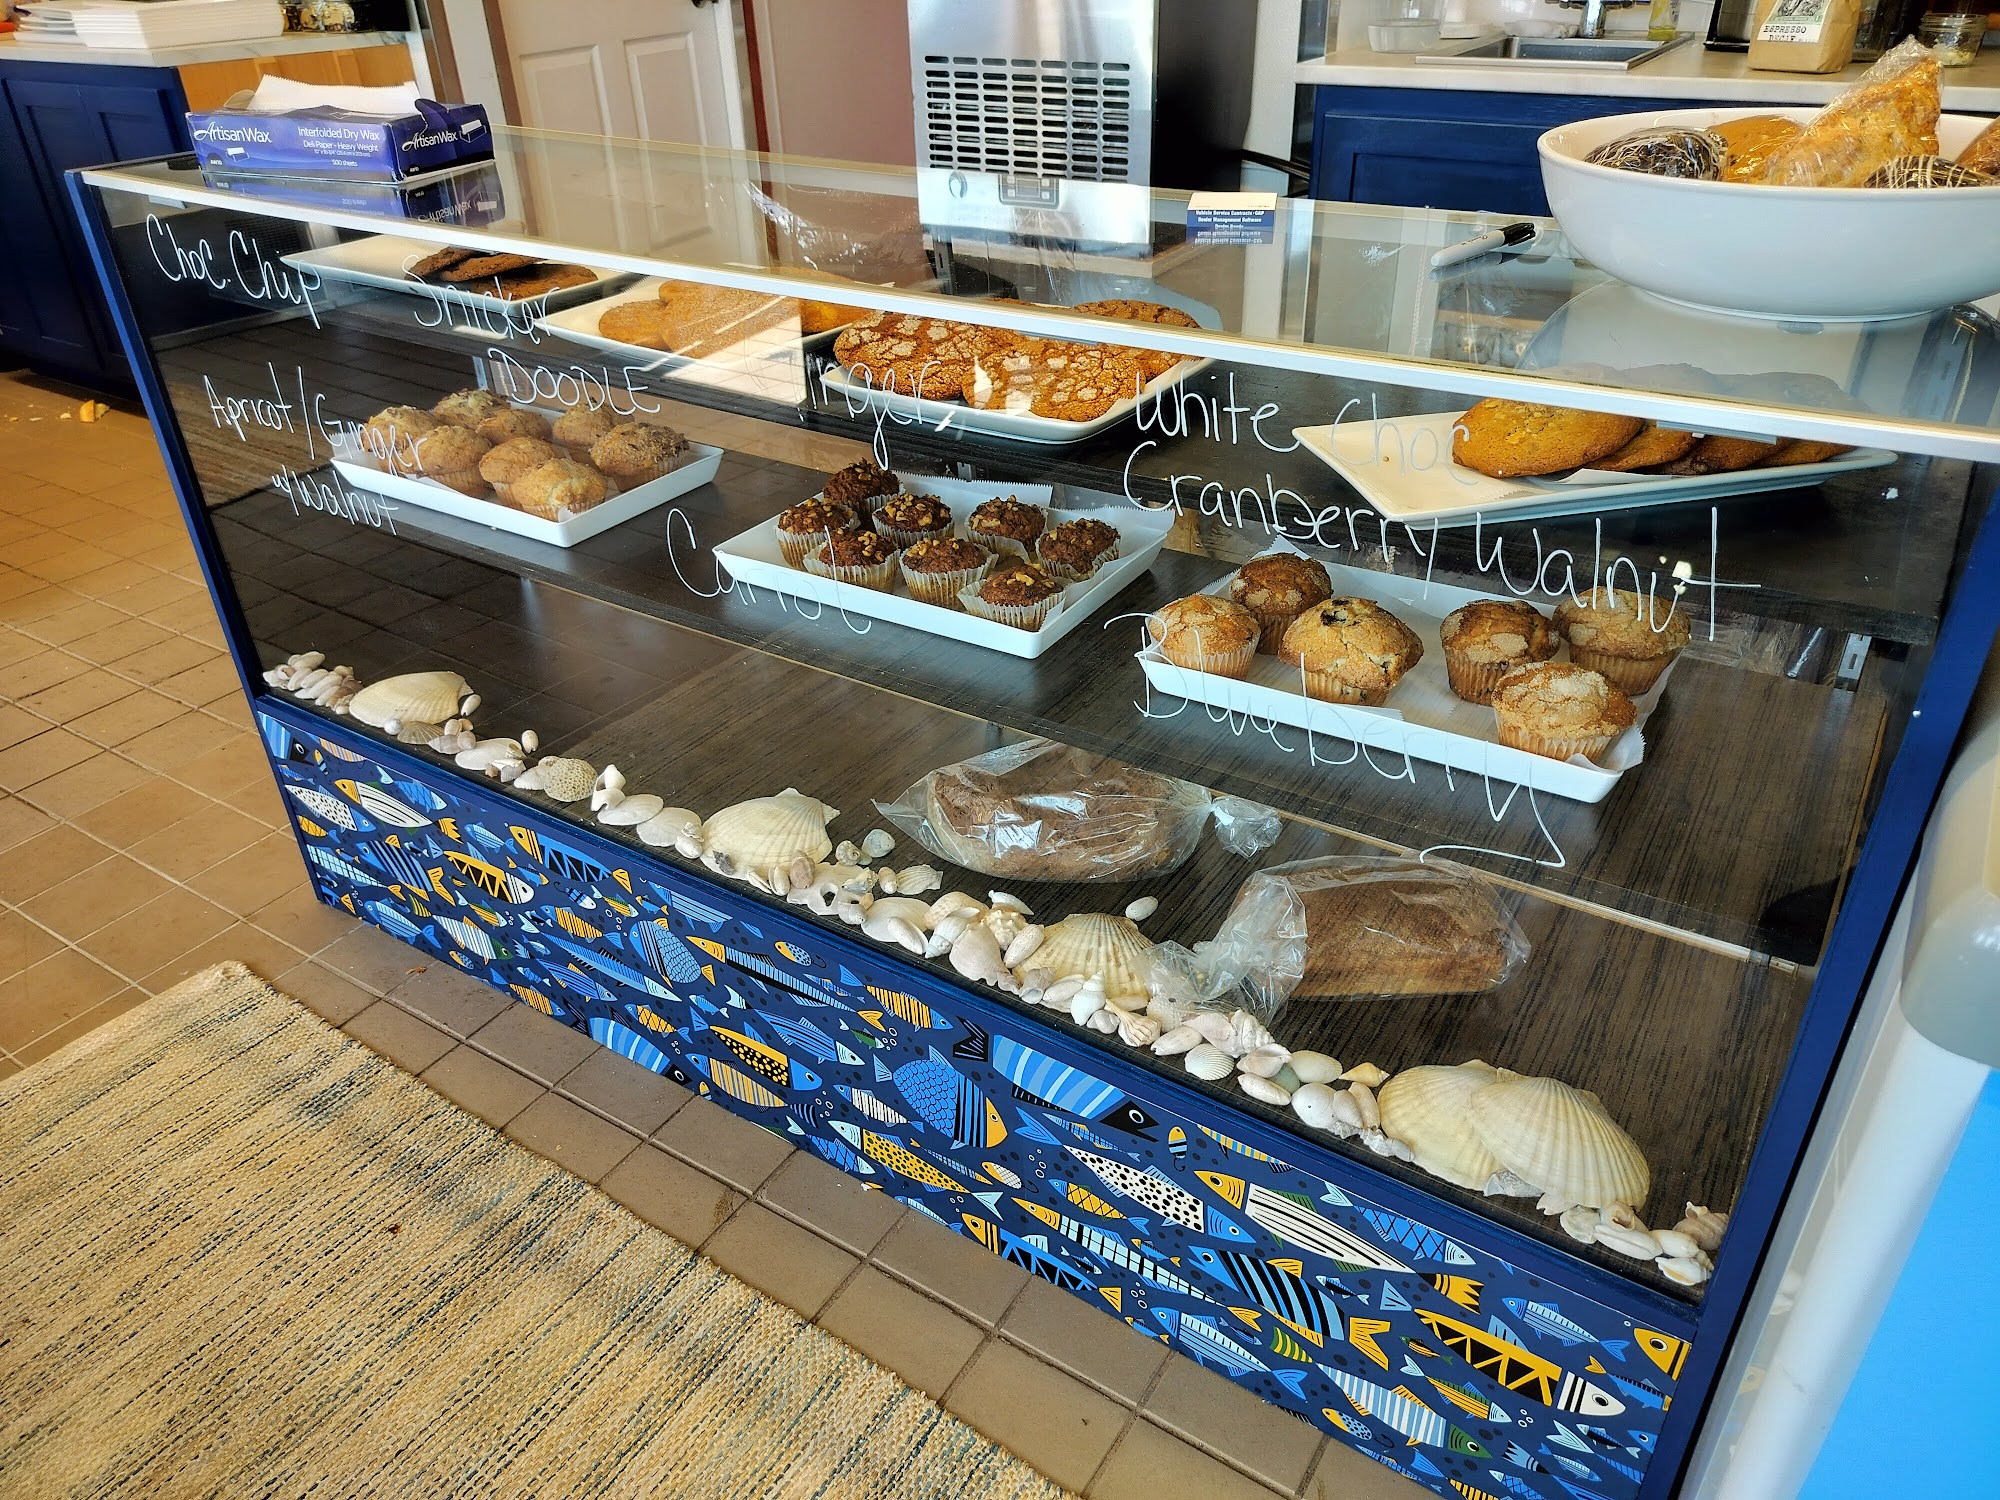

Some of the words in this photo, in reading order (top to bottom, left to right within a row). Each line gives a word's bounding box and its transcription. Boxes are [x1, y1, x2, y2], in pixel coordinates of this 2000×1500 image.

[1763, 25, 1807, 34] ESPRESSO
[193, 121, 273, 143] ArtisanWax
[297, 126, 343, 139] Interfolded
[343, 128, 359, 141] Dry
[359, 129, 380, 141] Wax
[315, 141, 333, 149] Paper
[337, 142, 356, 152] Heavy
[356, 142, 379, 153] Weight
[401, 130, 458, 152] ArtisanWax
[229, 230, 322, 330] Chip
[401, 254, 561, 345] Snicker
[487, 348, 661, 416] DOODLE
[1134, 371, 1299, 453] White
[1329, 391, 1480, 487] Choc
[666, 507, 872, 635] Carrot
[1123, 440, 1439, 600] Cranberry
[1475, 506, 1762, 642] Walnut
[1103, 611, 1566, 868] Blueberry
